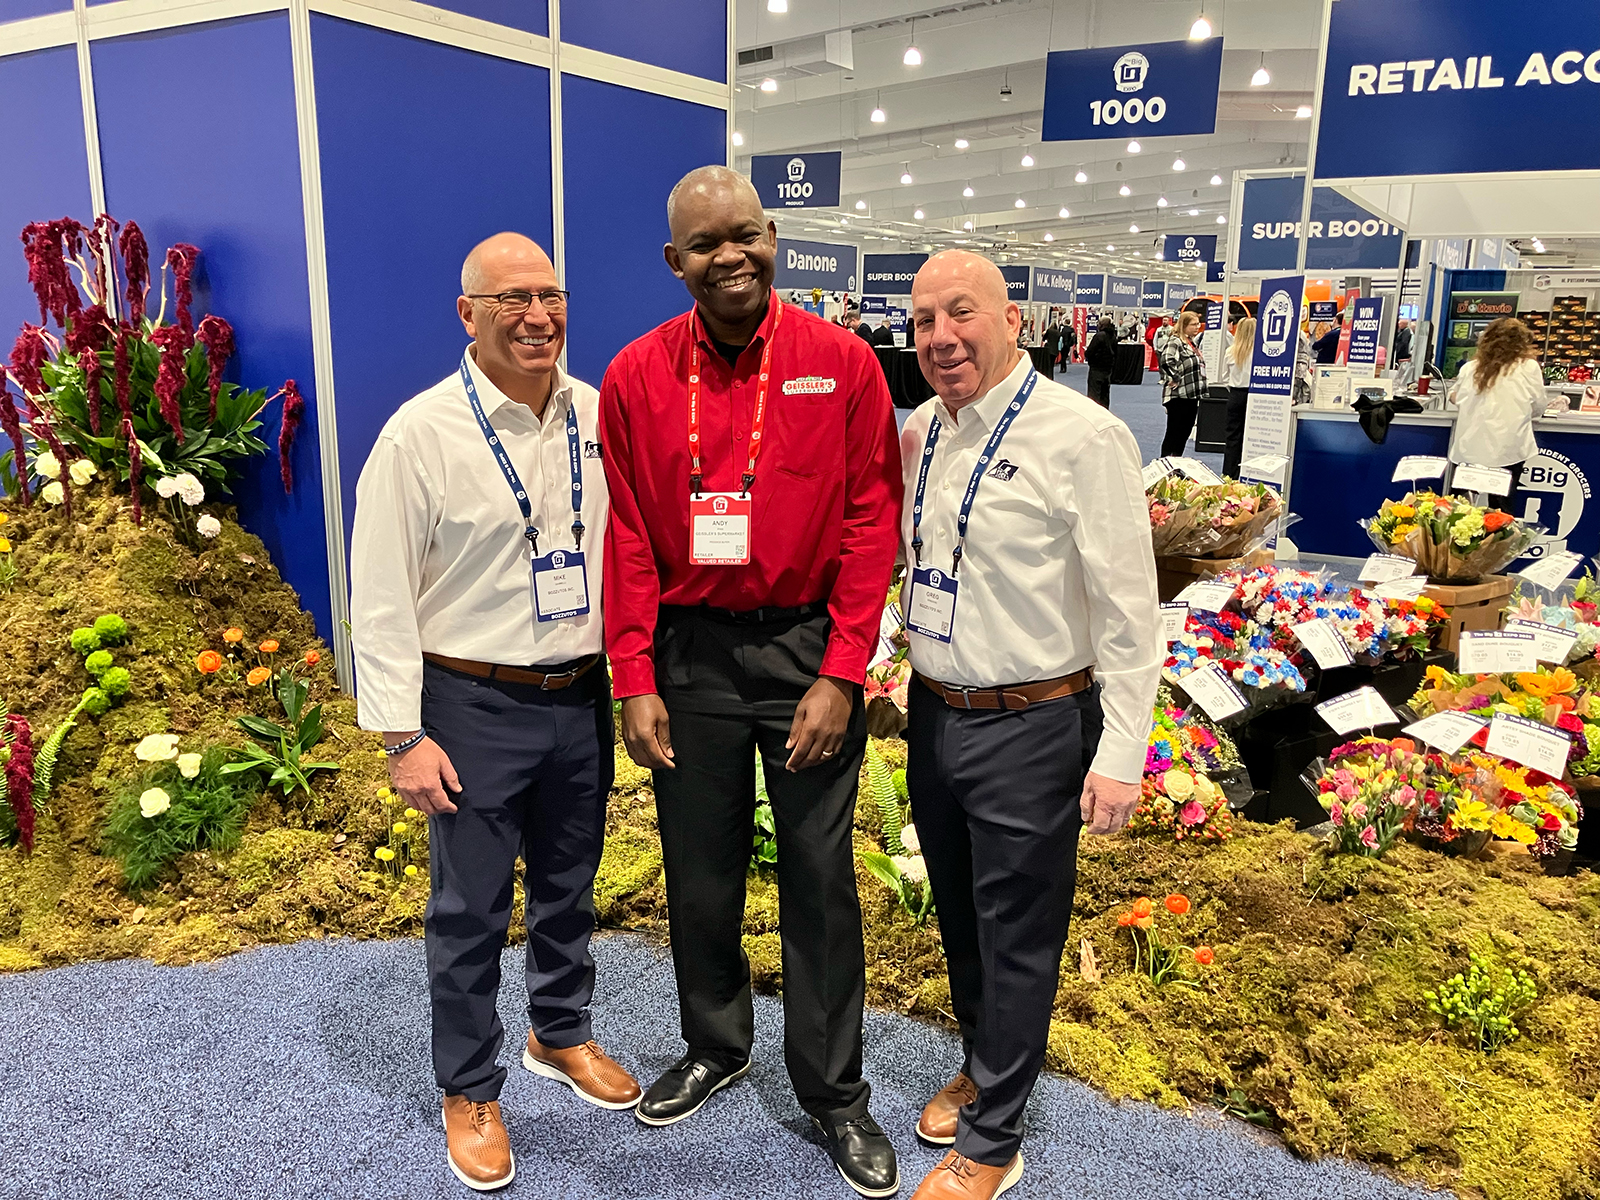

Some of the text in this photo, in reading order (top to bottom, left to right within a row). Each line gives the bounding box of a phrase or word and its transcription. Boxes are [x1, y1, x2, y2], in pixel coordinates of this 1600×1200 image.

[1348, 56, 1504, 96] RETAIL
[1090, 96, 1166, 125] 1000
[777, 182, 813, 199] 1100
[1252, 222, 1323, 240] SUPER
[1178, 249, 1200, 258] 1500
[787, 249, 837, 272] Danone
[1036, 273, 1072, 291] W.K. Kellogg
[1112, 282, 1136, 295] Kellanova
[1169, 289, 1184, 299] General
[1278, 301, 1288, 313] Big
[1360, 307, 1374, 318] WIN
[1353, 320, 1378, 331] PRIZES!
[1253, 366, 1290, 377] FREE WI-FI
[786, 382, 832, 390] GEISSLER'S
[990, 434, 998, 447] EXPO
[1530, 467, 1568, 487] Big
[1569, 463, 1592, 499] GROCERS
[926, 591, 939, 600] GREG
[551, 611, 577, 619] BOZZUTO'S
[917, 627, 939, 639] BOZZUTO'S
[1540, 725, 1555, 733] EXPO
[1537, 734, 1560, 746] BOUQUET
